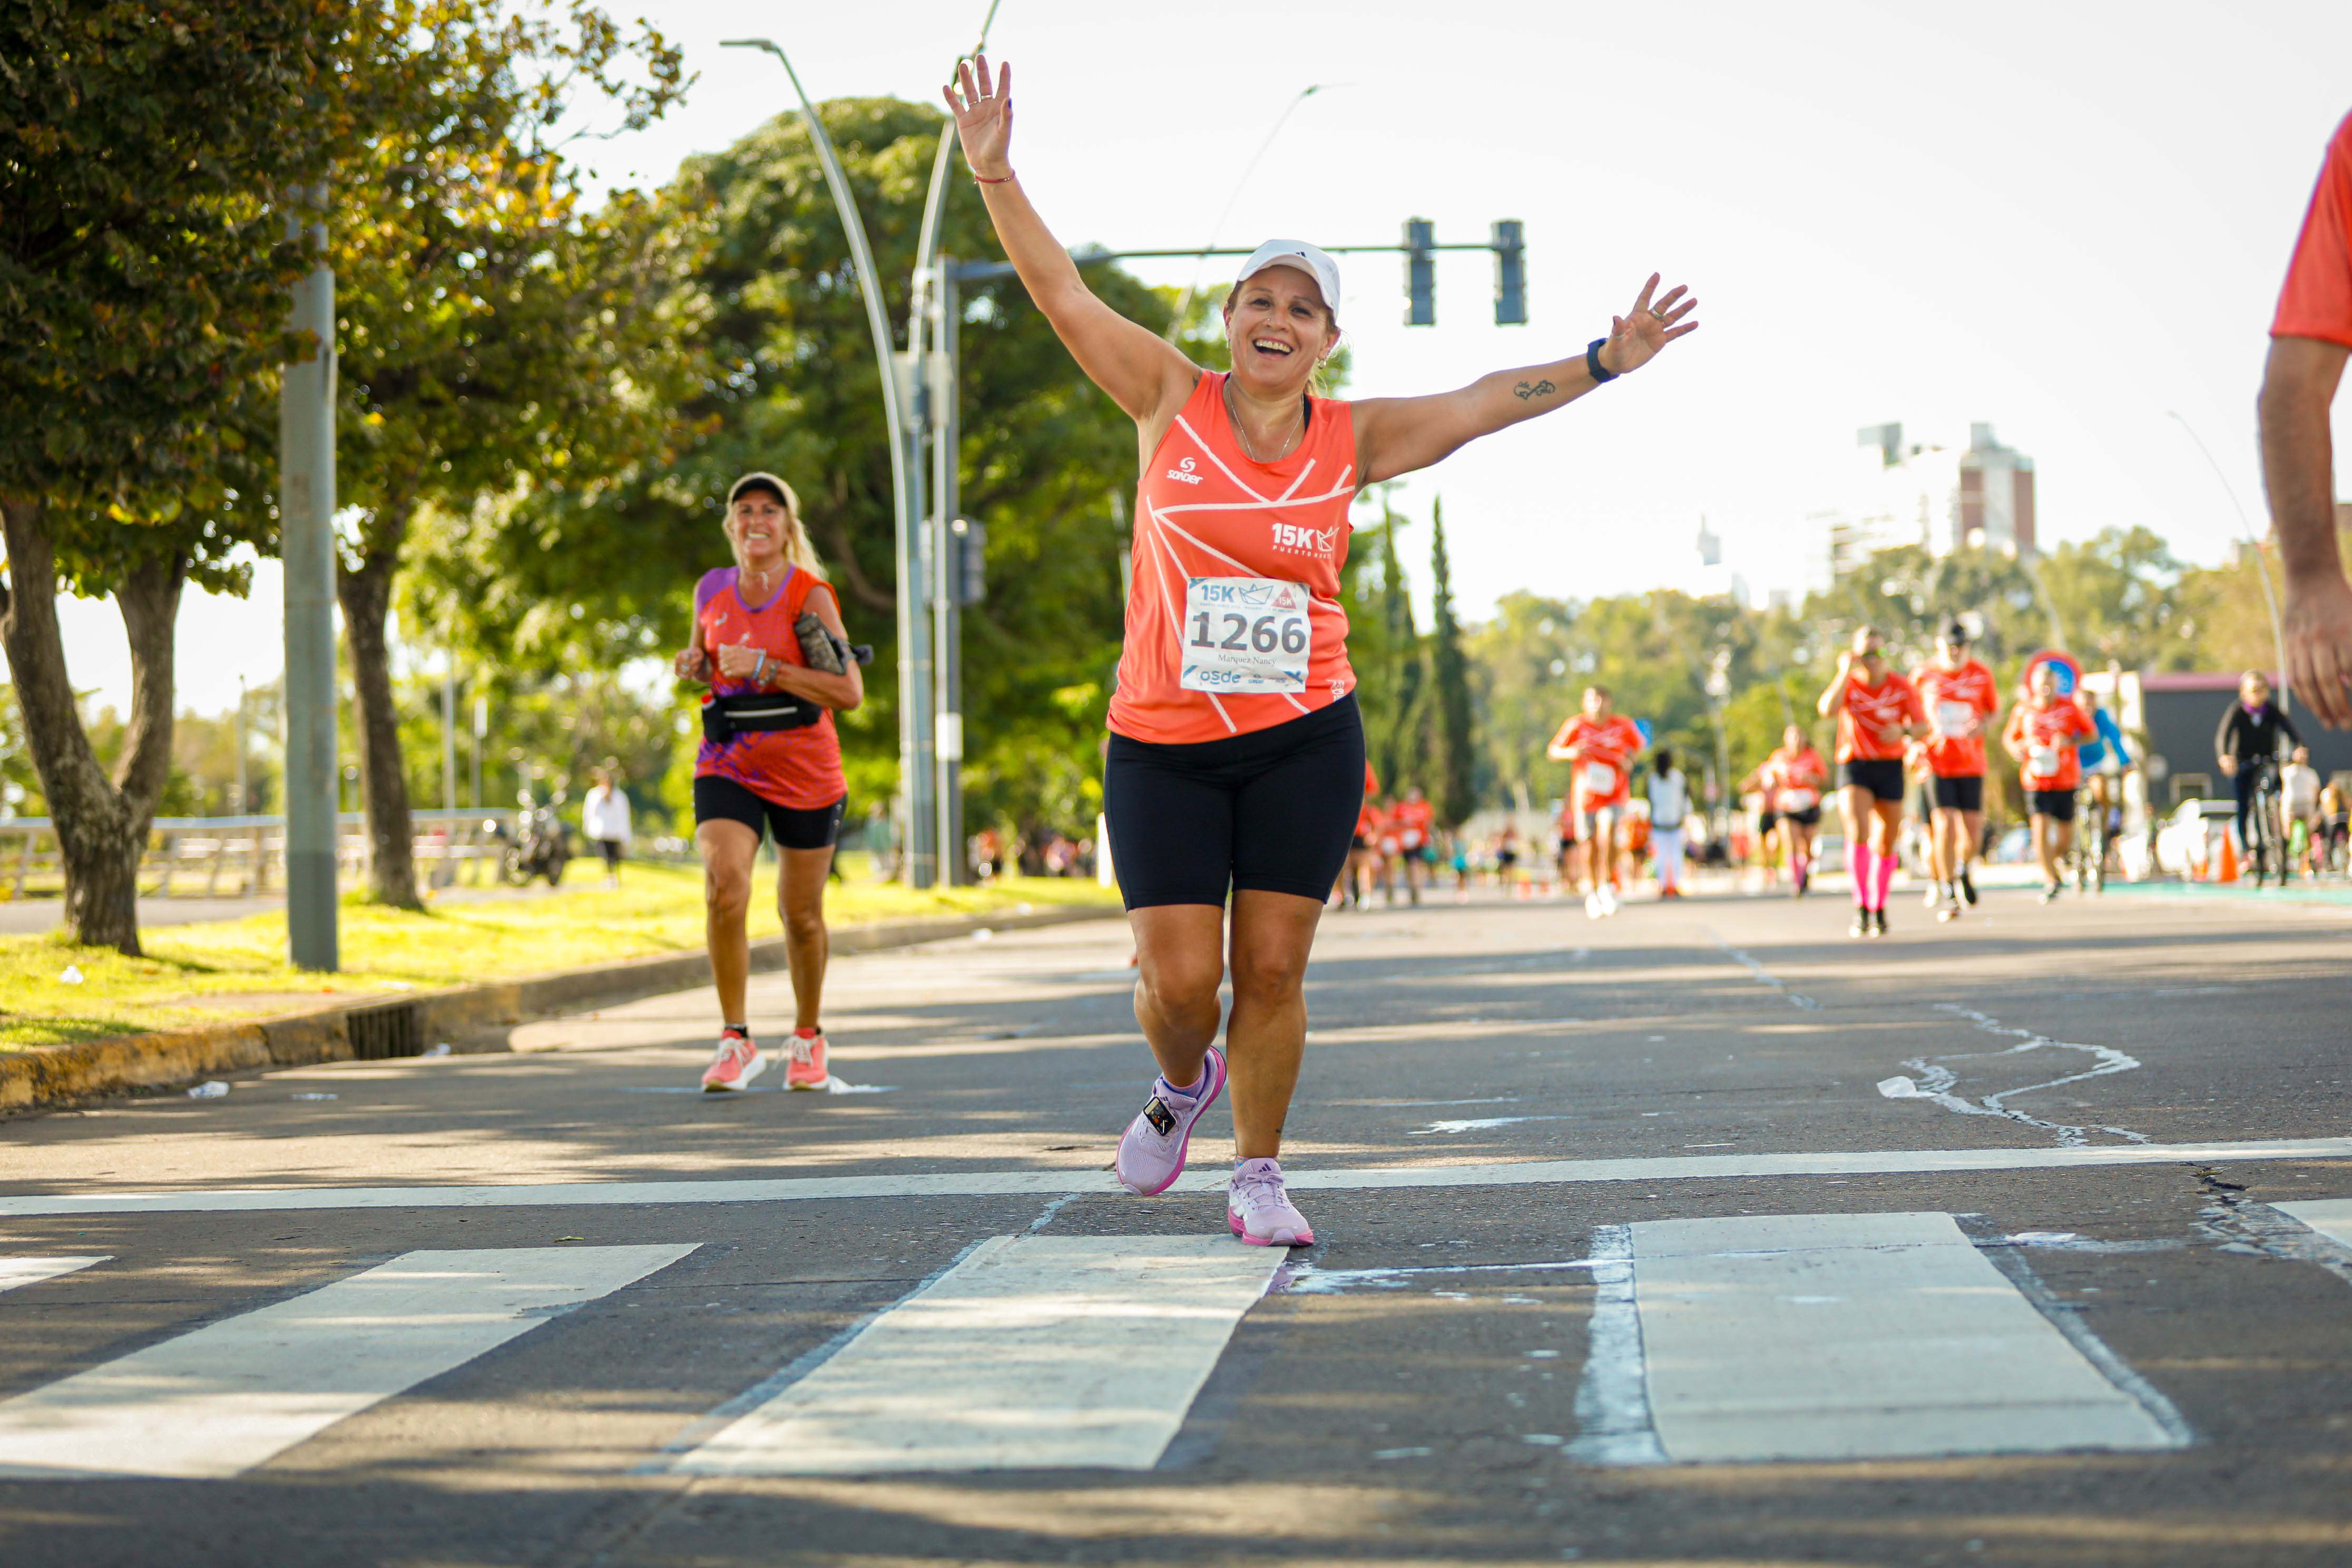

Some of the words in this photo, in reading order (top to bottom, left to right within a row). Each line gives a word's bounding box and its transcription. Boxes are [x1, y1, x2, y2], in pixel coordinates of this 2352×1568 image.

[1272, 522, 1316, 550] 15K
[1272, 545, 1311, 557] PUERTO
[1201, 584, 1235, 602] 15K
[1279, 596, 1292, 606] 15K
[1191, 611, 1306, 653] 1266
[1218, 654, 1250, 664] Marquez
[1251, 656, 1277, 666] Nancy
